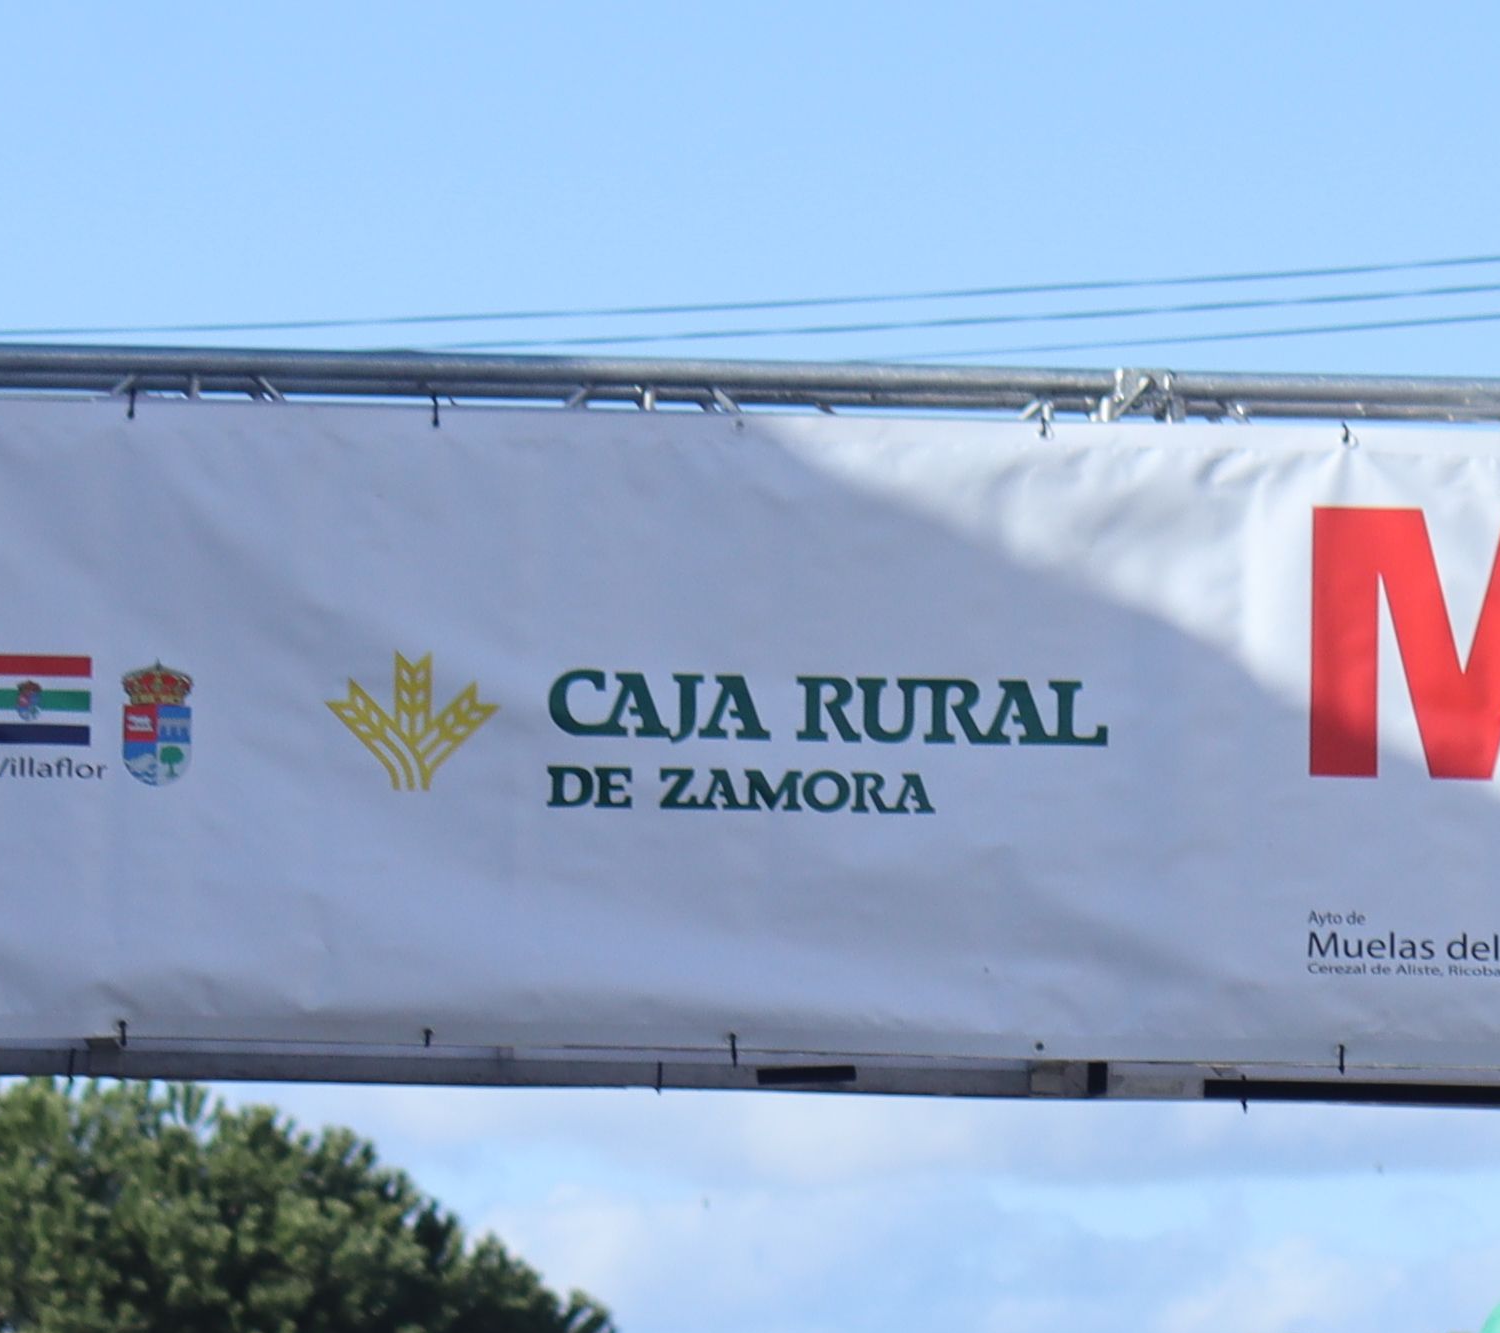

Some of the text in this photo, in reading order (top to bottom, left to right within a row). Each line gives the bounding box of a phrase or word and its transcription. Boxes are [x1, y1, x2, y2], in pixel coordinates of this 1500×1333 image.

[549, 669, 1108, 746] CAJA RURAL
[547, 766, 934, 813] DE ZAMORA
[1309, 910, 1365, 927] Ayto de
[1308, 932, 1434, 959] Muelas
[1447, 933, 1498, 961] del
[1308, 963, 1364, 974] Cerezal
[1370, 963, 1389, 975] de
[1396, 965, 1442, 976] Aliste,
